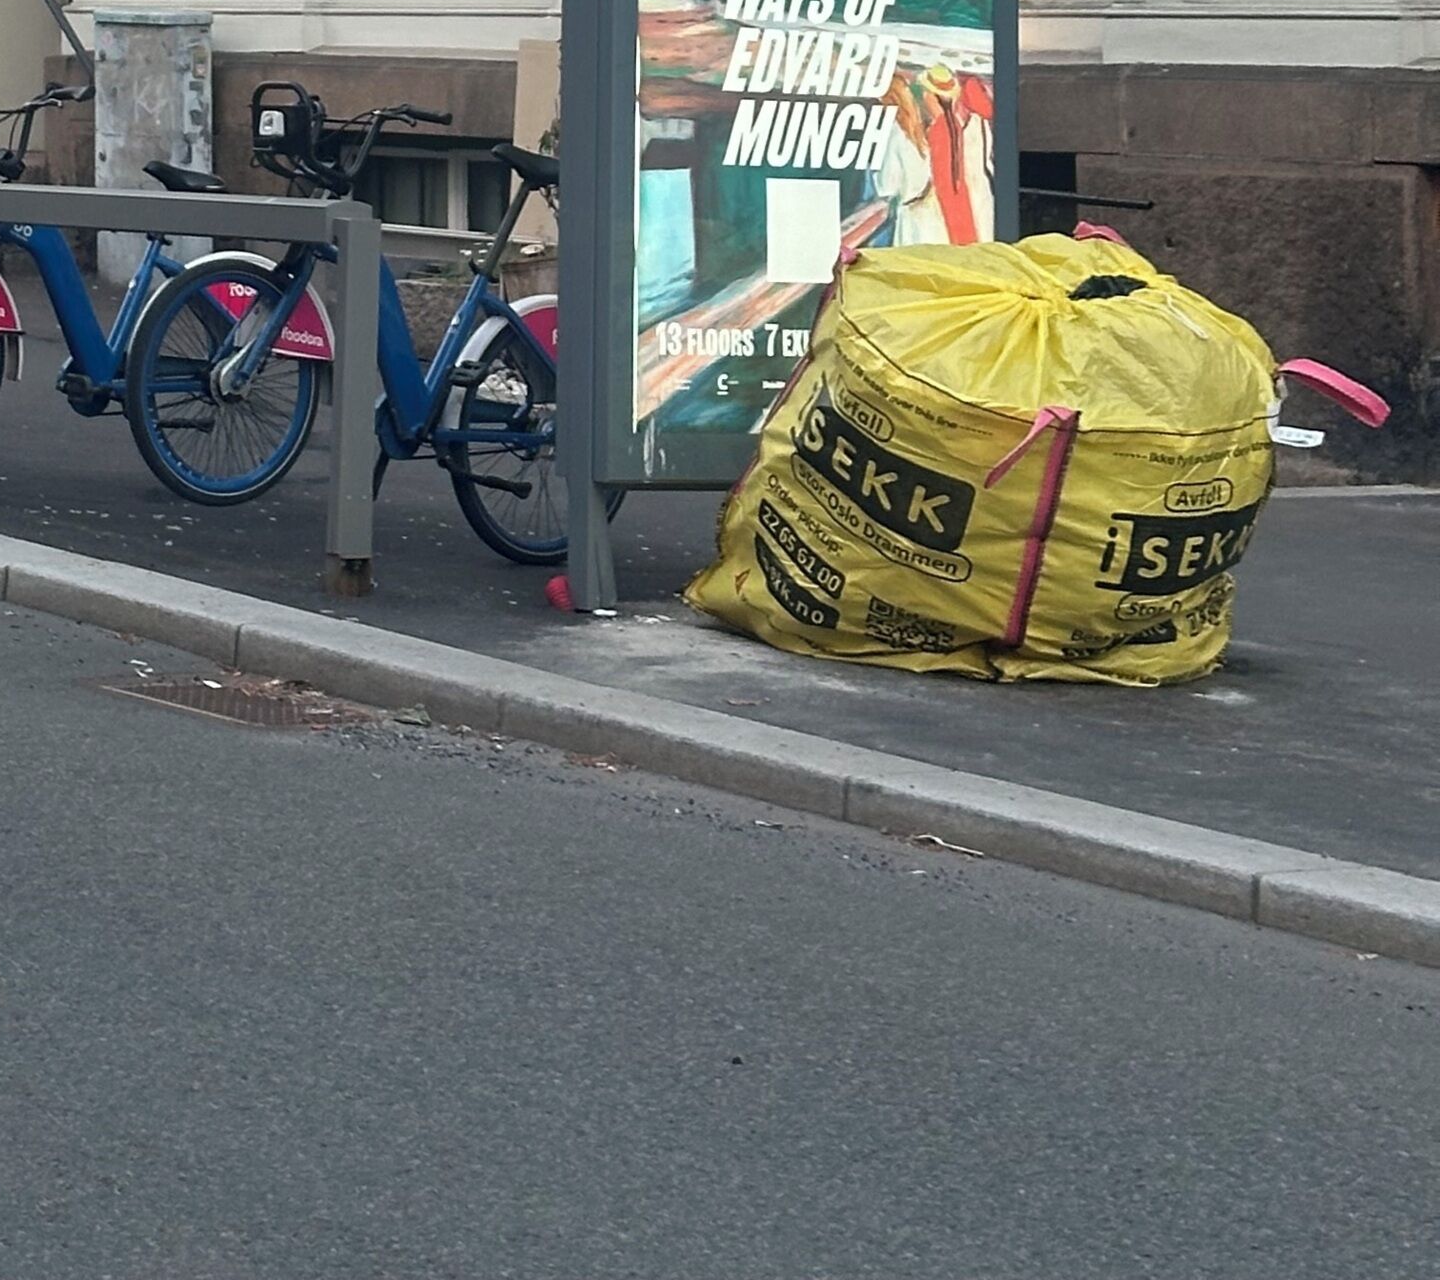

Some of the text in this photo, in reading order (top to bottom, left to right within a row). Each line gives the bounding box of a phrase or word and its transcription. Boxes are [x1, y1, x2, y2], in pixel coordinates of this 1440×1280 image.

[721, 27, 901, 99] EDVARD
[721, 99, 899, 172] MUNCH
[280, 325, 325, 347] foodora
[656, 321, 682, 357] 13
[686, 327, 755, 358] FLOORS
[764, 323, 780, 358] 7
[803, 408, 951, 534] SEKK
[762, 505, 842, 593] 22 65 61 00
[862, 522, 958, 576] Drammen
